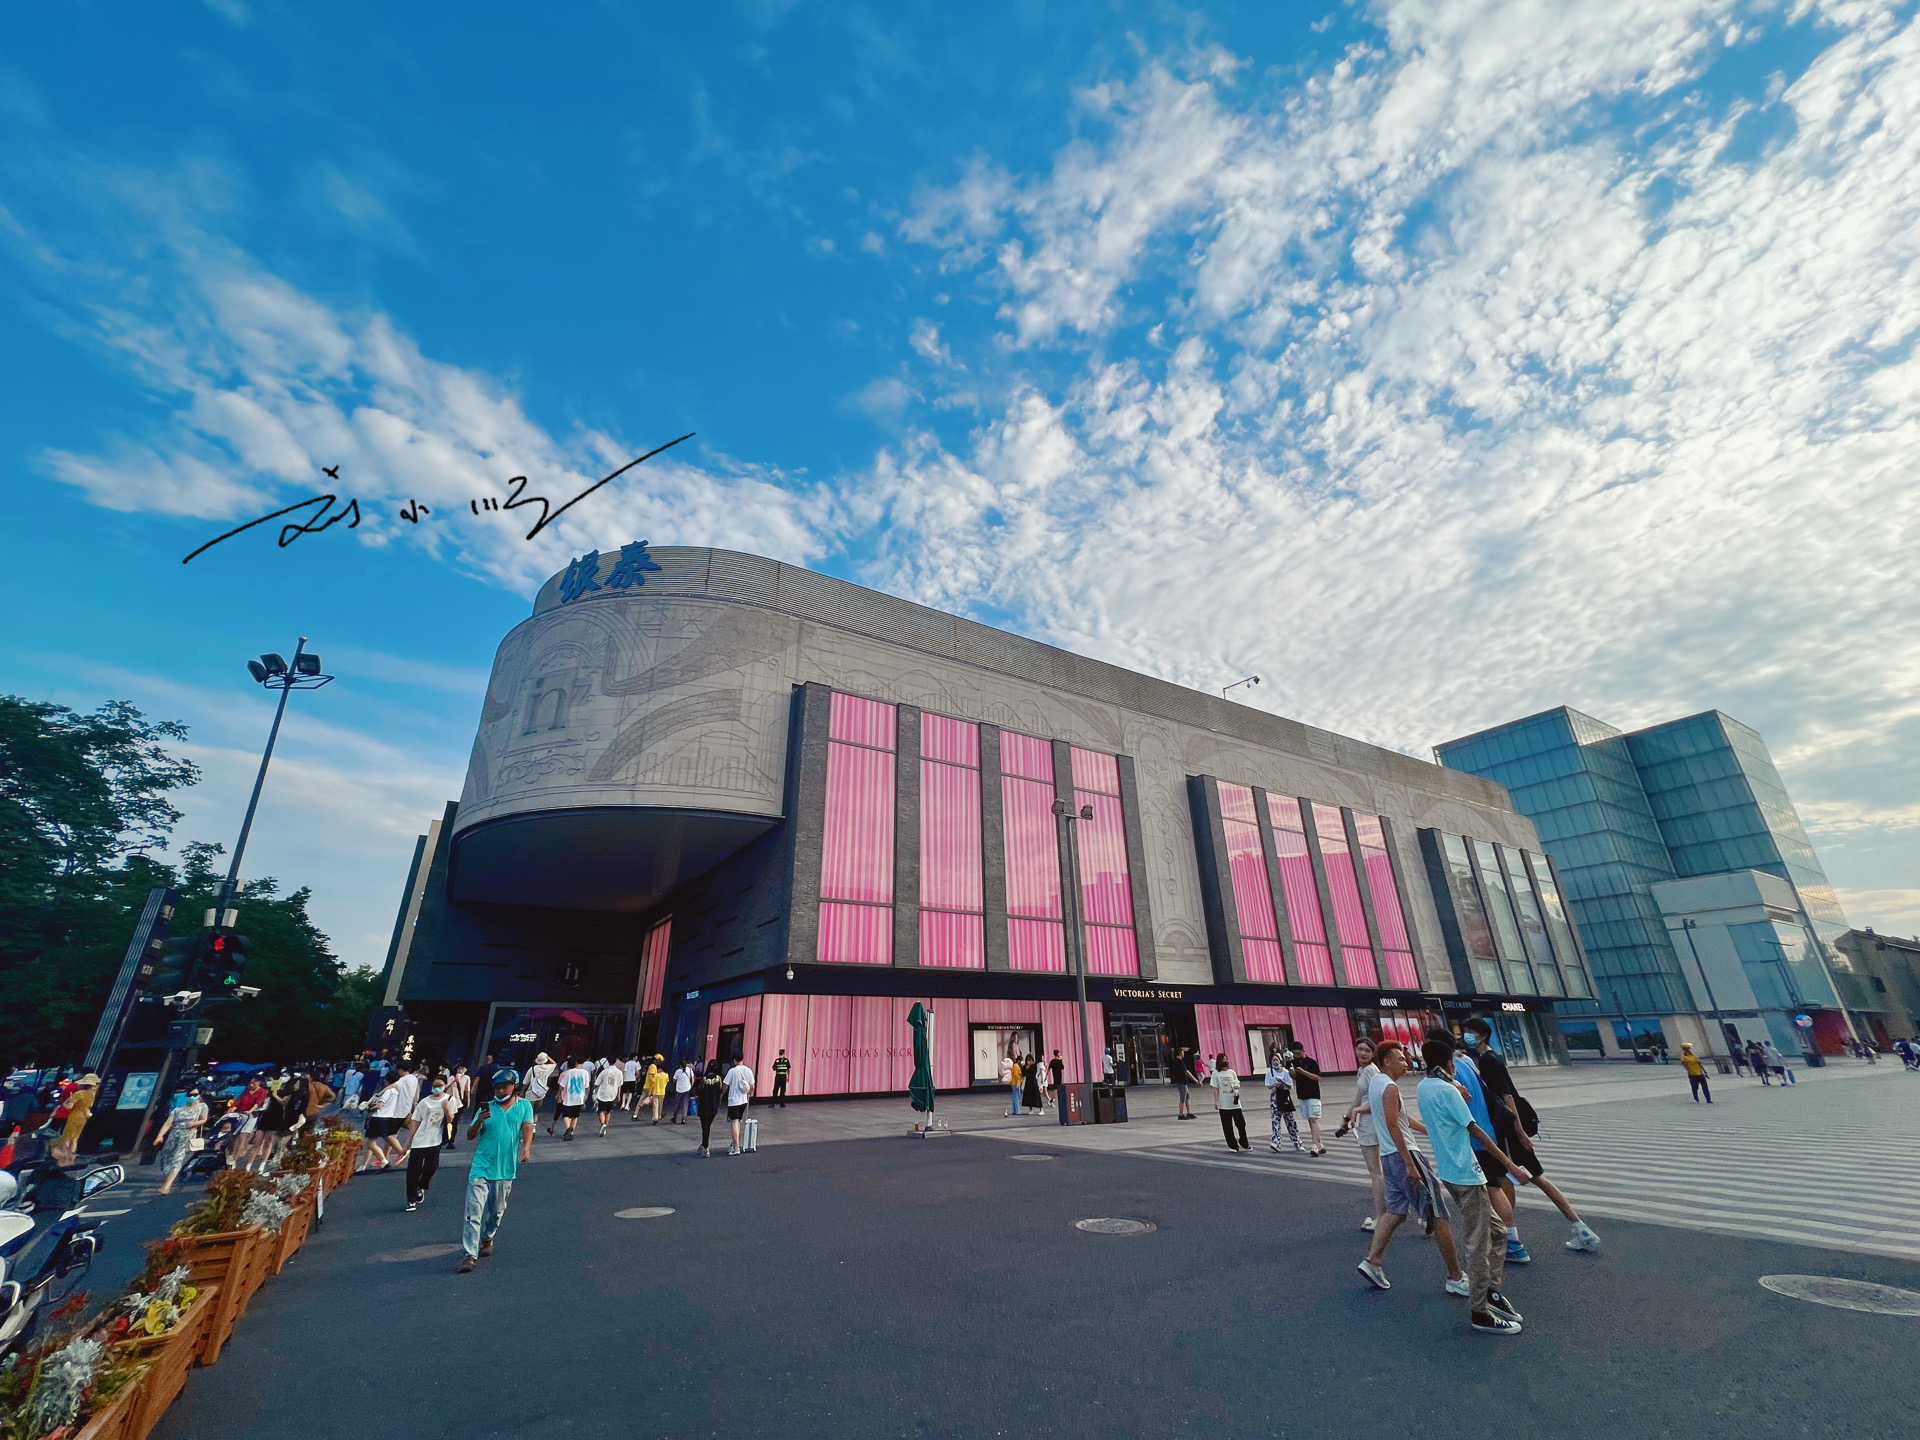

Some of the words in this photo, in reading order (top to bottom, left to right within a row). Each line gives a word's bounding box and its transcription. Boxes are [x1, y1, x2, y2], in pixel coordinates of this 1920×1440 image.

[560, 539, 662, 603] 银泰
[1114, 988, 1155, 998] VICTORIA'S
[1158, 989, 1182, 999] SECRET
[1501, 1002, 1526, 1012] CHANEL
[812, 1047, 880, 1059] VICTORIA'S
[886, 1047, 913, 1058] SECR
